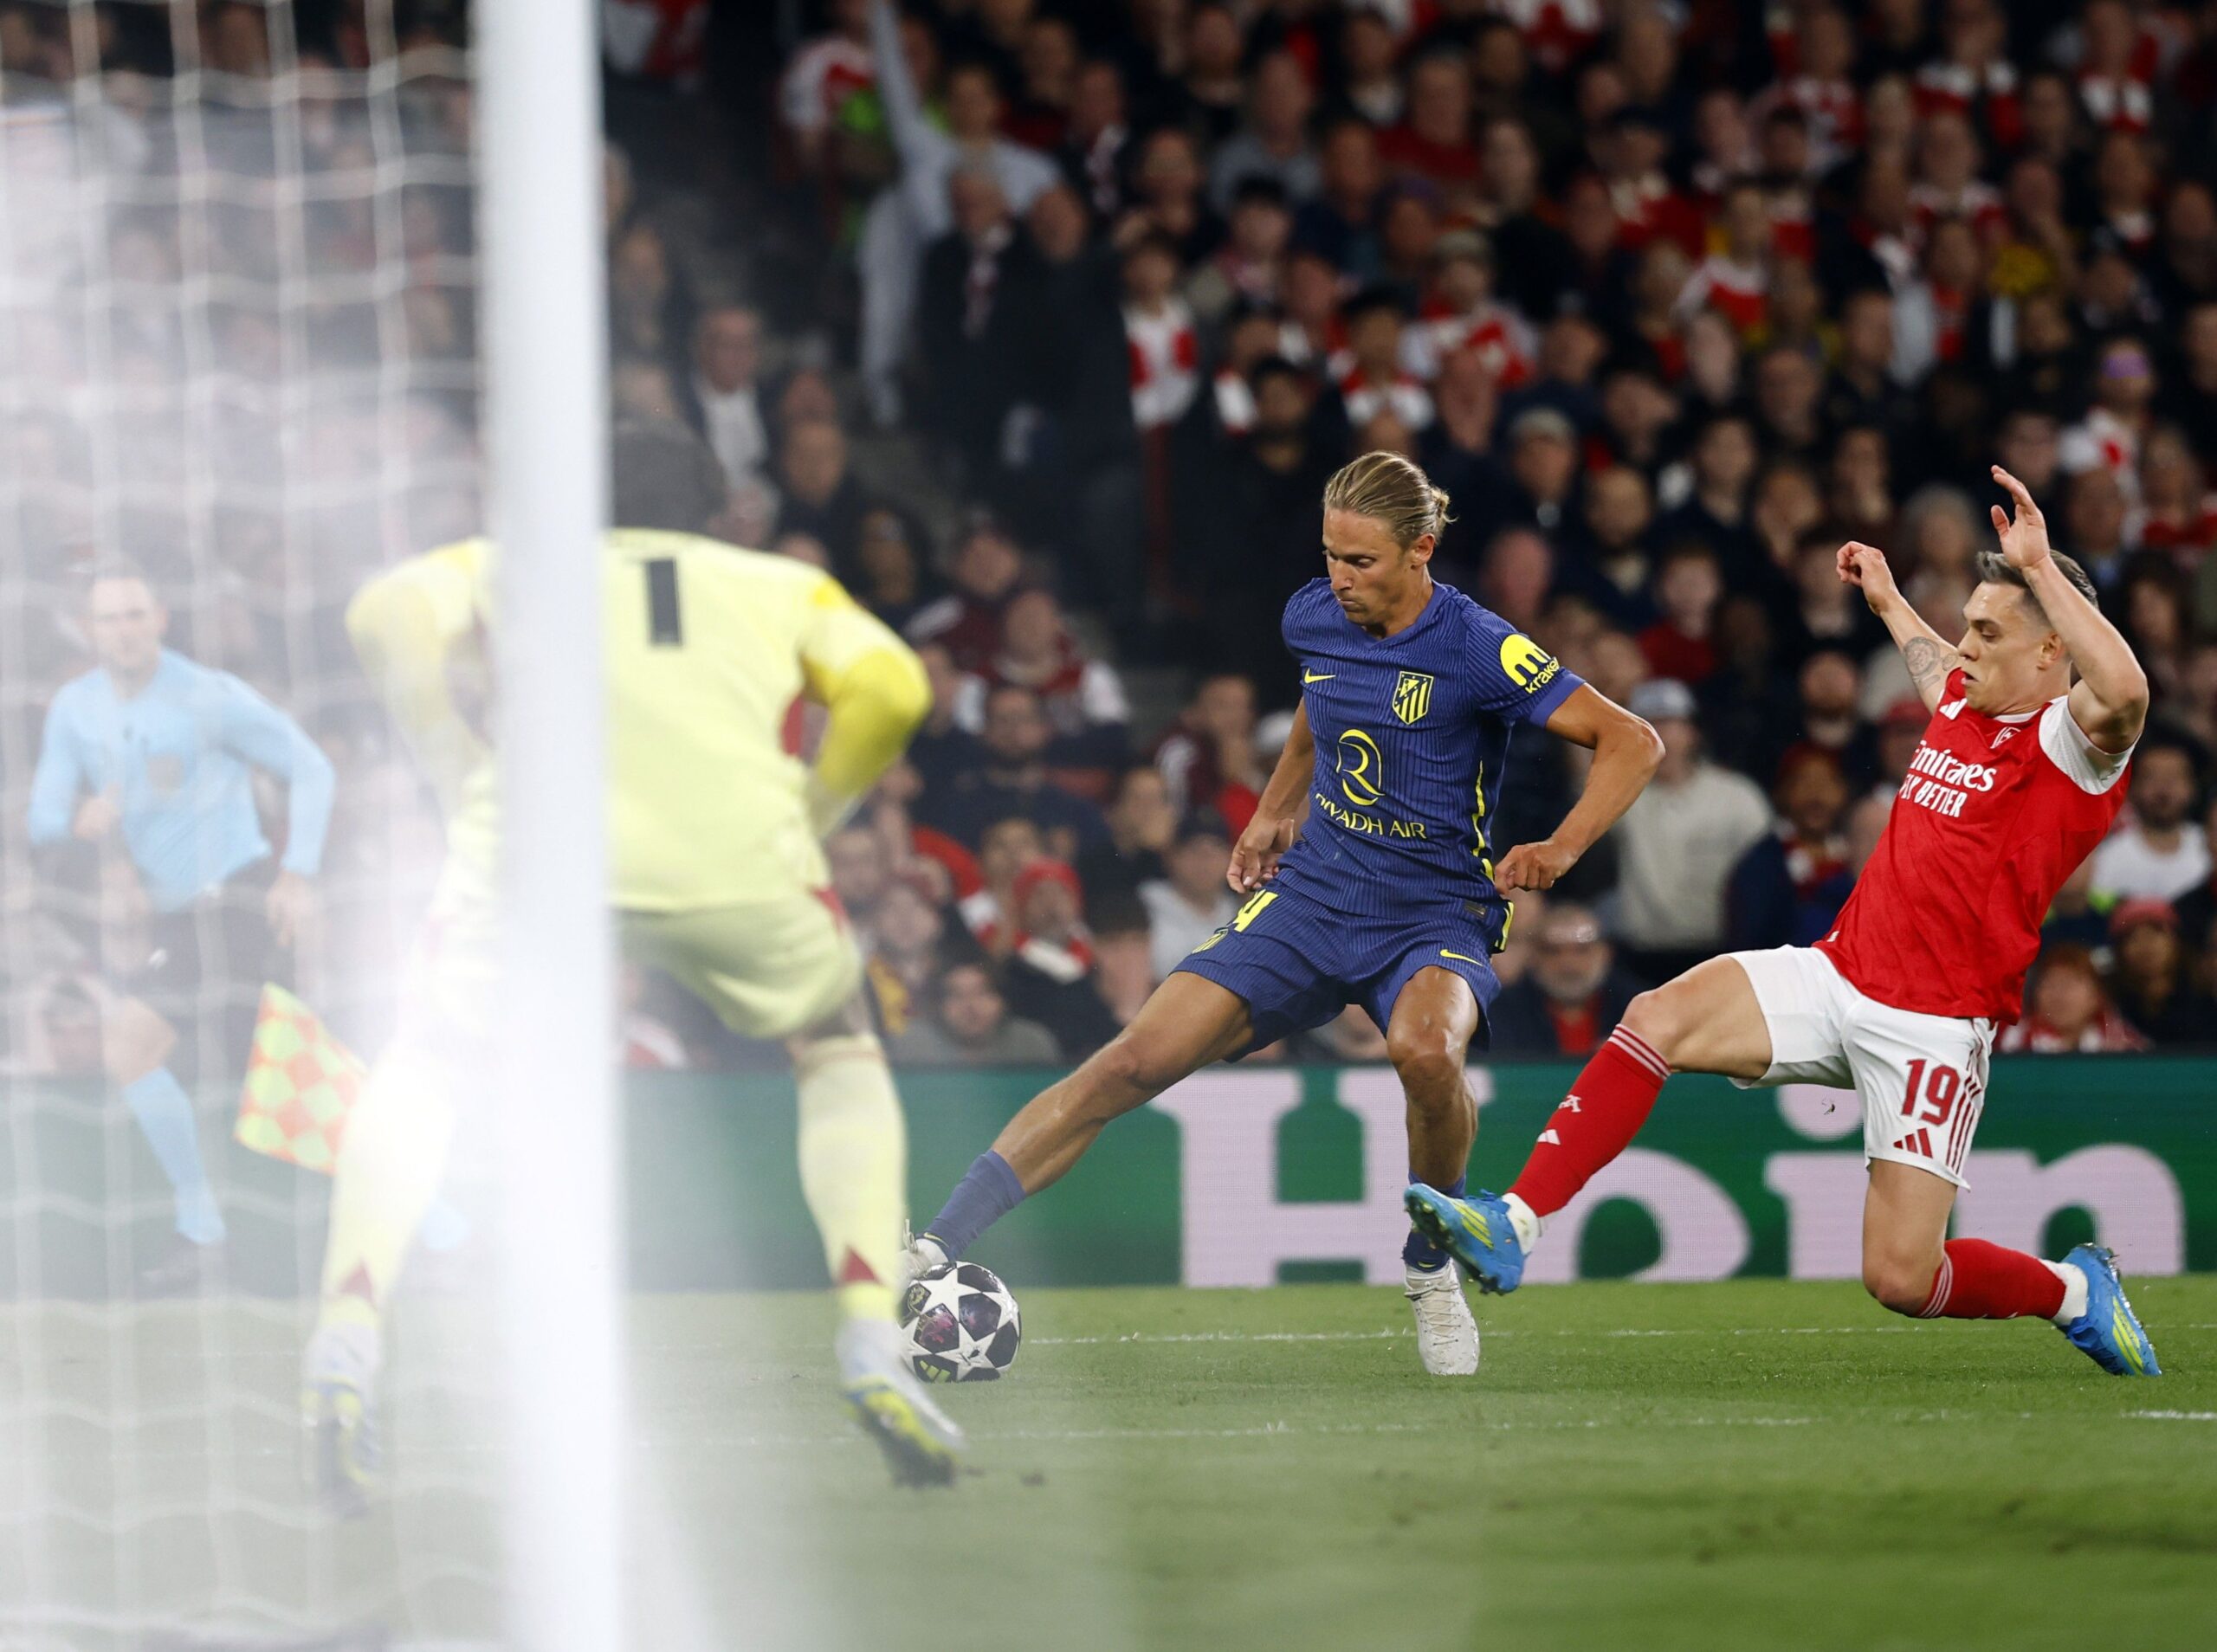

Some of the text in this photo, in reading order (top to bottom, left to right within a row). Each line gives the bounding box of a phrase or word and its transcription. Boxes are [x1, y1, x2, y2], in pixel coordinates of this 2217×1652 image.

[1909, 739, 1997, 792] miraes
[1913, 780, 1968, 818] BETTER
[1389, 820, 1427, 839] AIR
[1901, 1058, 1961, 1126] 19
